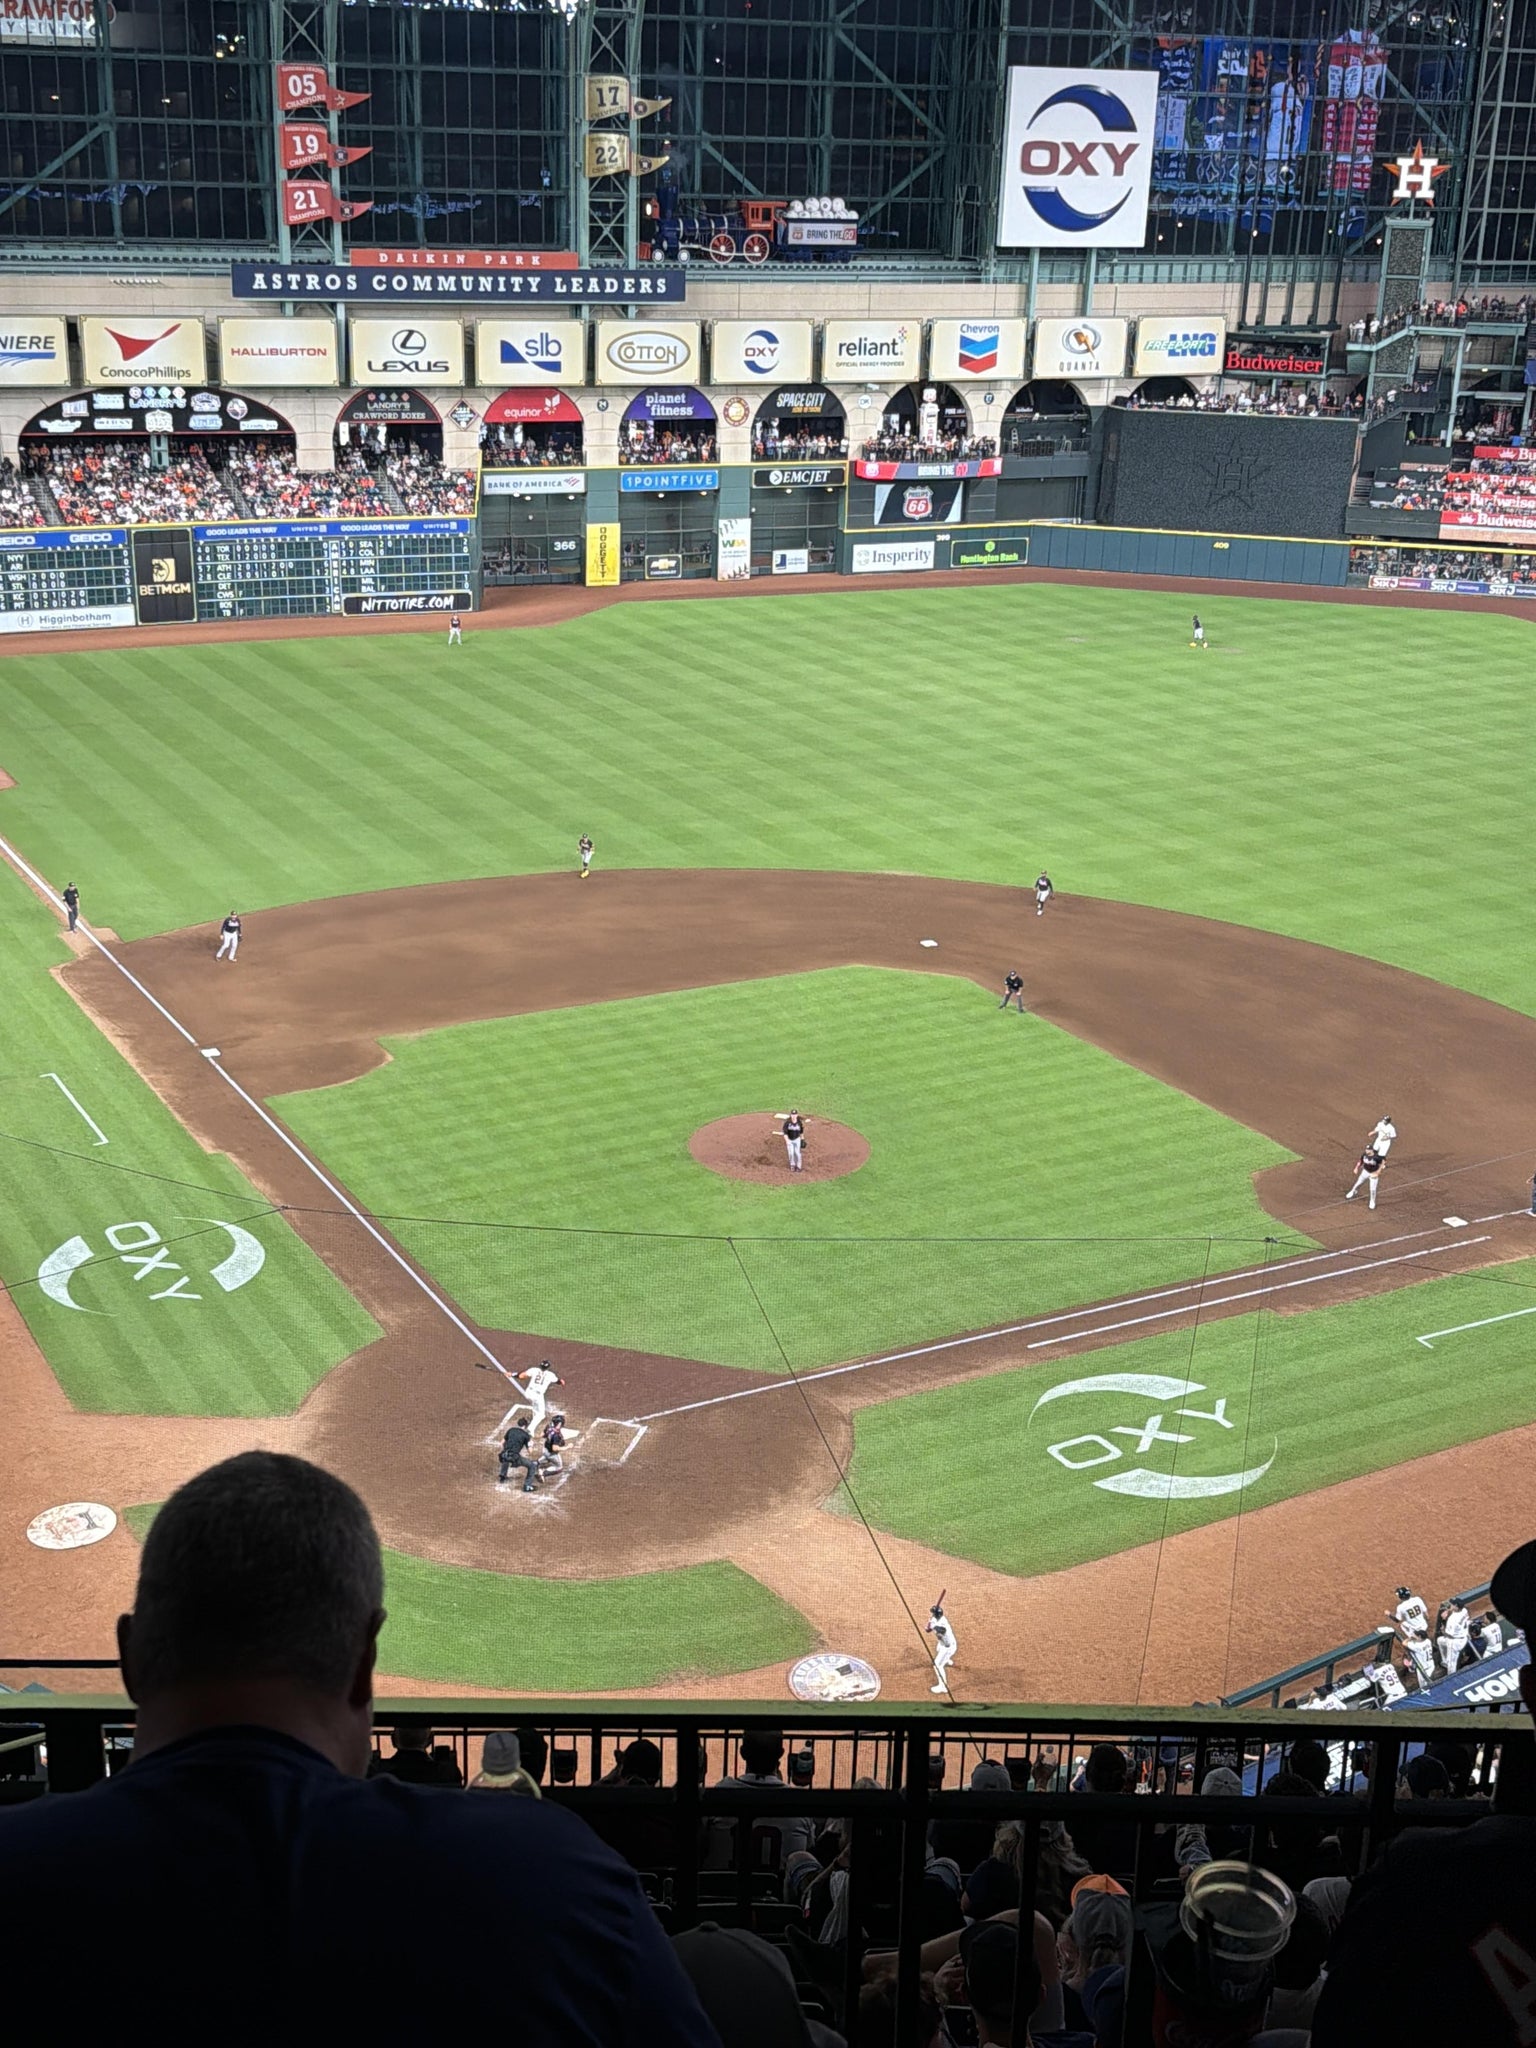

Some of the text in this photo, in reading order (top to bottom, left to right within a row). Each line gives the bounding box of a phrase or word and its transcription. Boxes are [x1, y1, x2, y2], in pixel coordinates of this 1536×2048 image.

[288, 74, 316, 97] 05
[286, 94, 326, 108] CHAMPIONS
[596, 86, 619, 106] 17
[292, 134, 318, 155] 19
[289, 152, 327, 166] CHAMPIONS
[596, 146, 618, 164] 22
[1020, 140, 1140, 177] OXY
[1393, 157, 1437, 199] H
[293, 190, 318, 210] 21
[289, 209, 325, 222] CHAMPIONS
[807, 230, 828, 240] BRING
[828, 230, 842, 240] THE
[379, 254, 542, 266] DAIKIN PARK
[252, 273, 668, 294] ASTROS COMMUNITY LEADERS
[960, 324, 999, 334] Chevron
[231, 347, 326, 356] HALLIBURTON
[525, 333, 562, 358] slb
[838, 336, 900, 356] reliant
[1144, 332, 1217, 357] FREEPORT LNG
[617, 341, 677, 365] COTTON
[744, 346, 778, 358] OXY
[367, 360, 450, 373] LEXUS
[1059, 360, 1100, 372] QUANTA
[1226, 352, 1322, 374] Budweiser
[100, 366, 191, 380] ConocoPhillips
[646, 392, 686, 406] planet
[776, 392, 826, 408] SPACE CITY
[353, 412, 426, 420] CRAWFORD BOXES
[504, 406, 542, 419] equinor
[650, 405, 692, 416] fitness
[488, 480, 511, 490] BANK
[526, 480, 562, 488] AMERICA
[626, 474, 714, 488] 1POINTFIVE
[782, 470, 830, 486] EMCJET
[908, 499, 927, 512] 66
[70, 532, 112, 544] GEICO
[206, 528, 227, 536] GOOD
[228, 527, 249, 535] LEADS
[554, 541, 576, 550] 366
[1213, 542, 1229, 550] 409
[872, 548, 931, 565] Insperity
[960, 552, 1019, 564] Huntington Bank
[140, 583, 192, 596] BETMGM
[361, 595, 454, 612] NITTOTIRE.COM
[40, 614, 112, 626] Higginbotham
[104, 1222, 202, 1300] OXY
[1047, 1398, 1234, 1470] OXY
